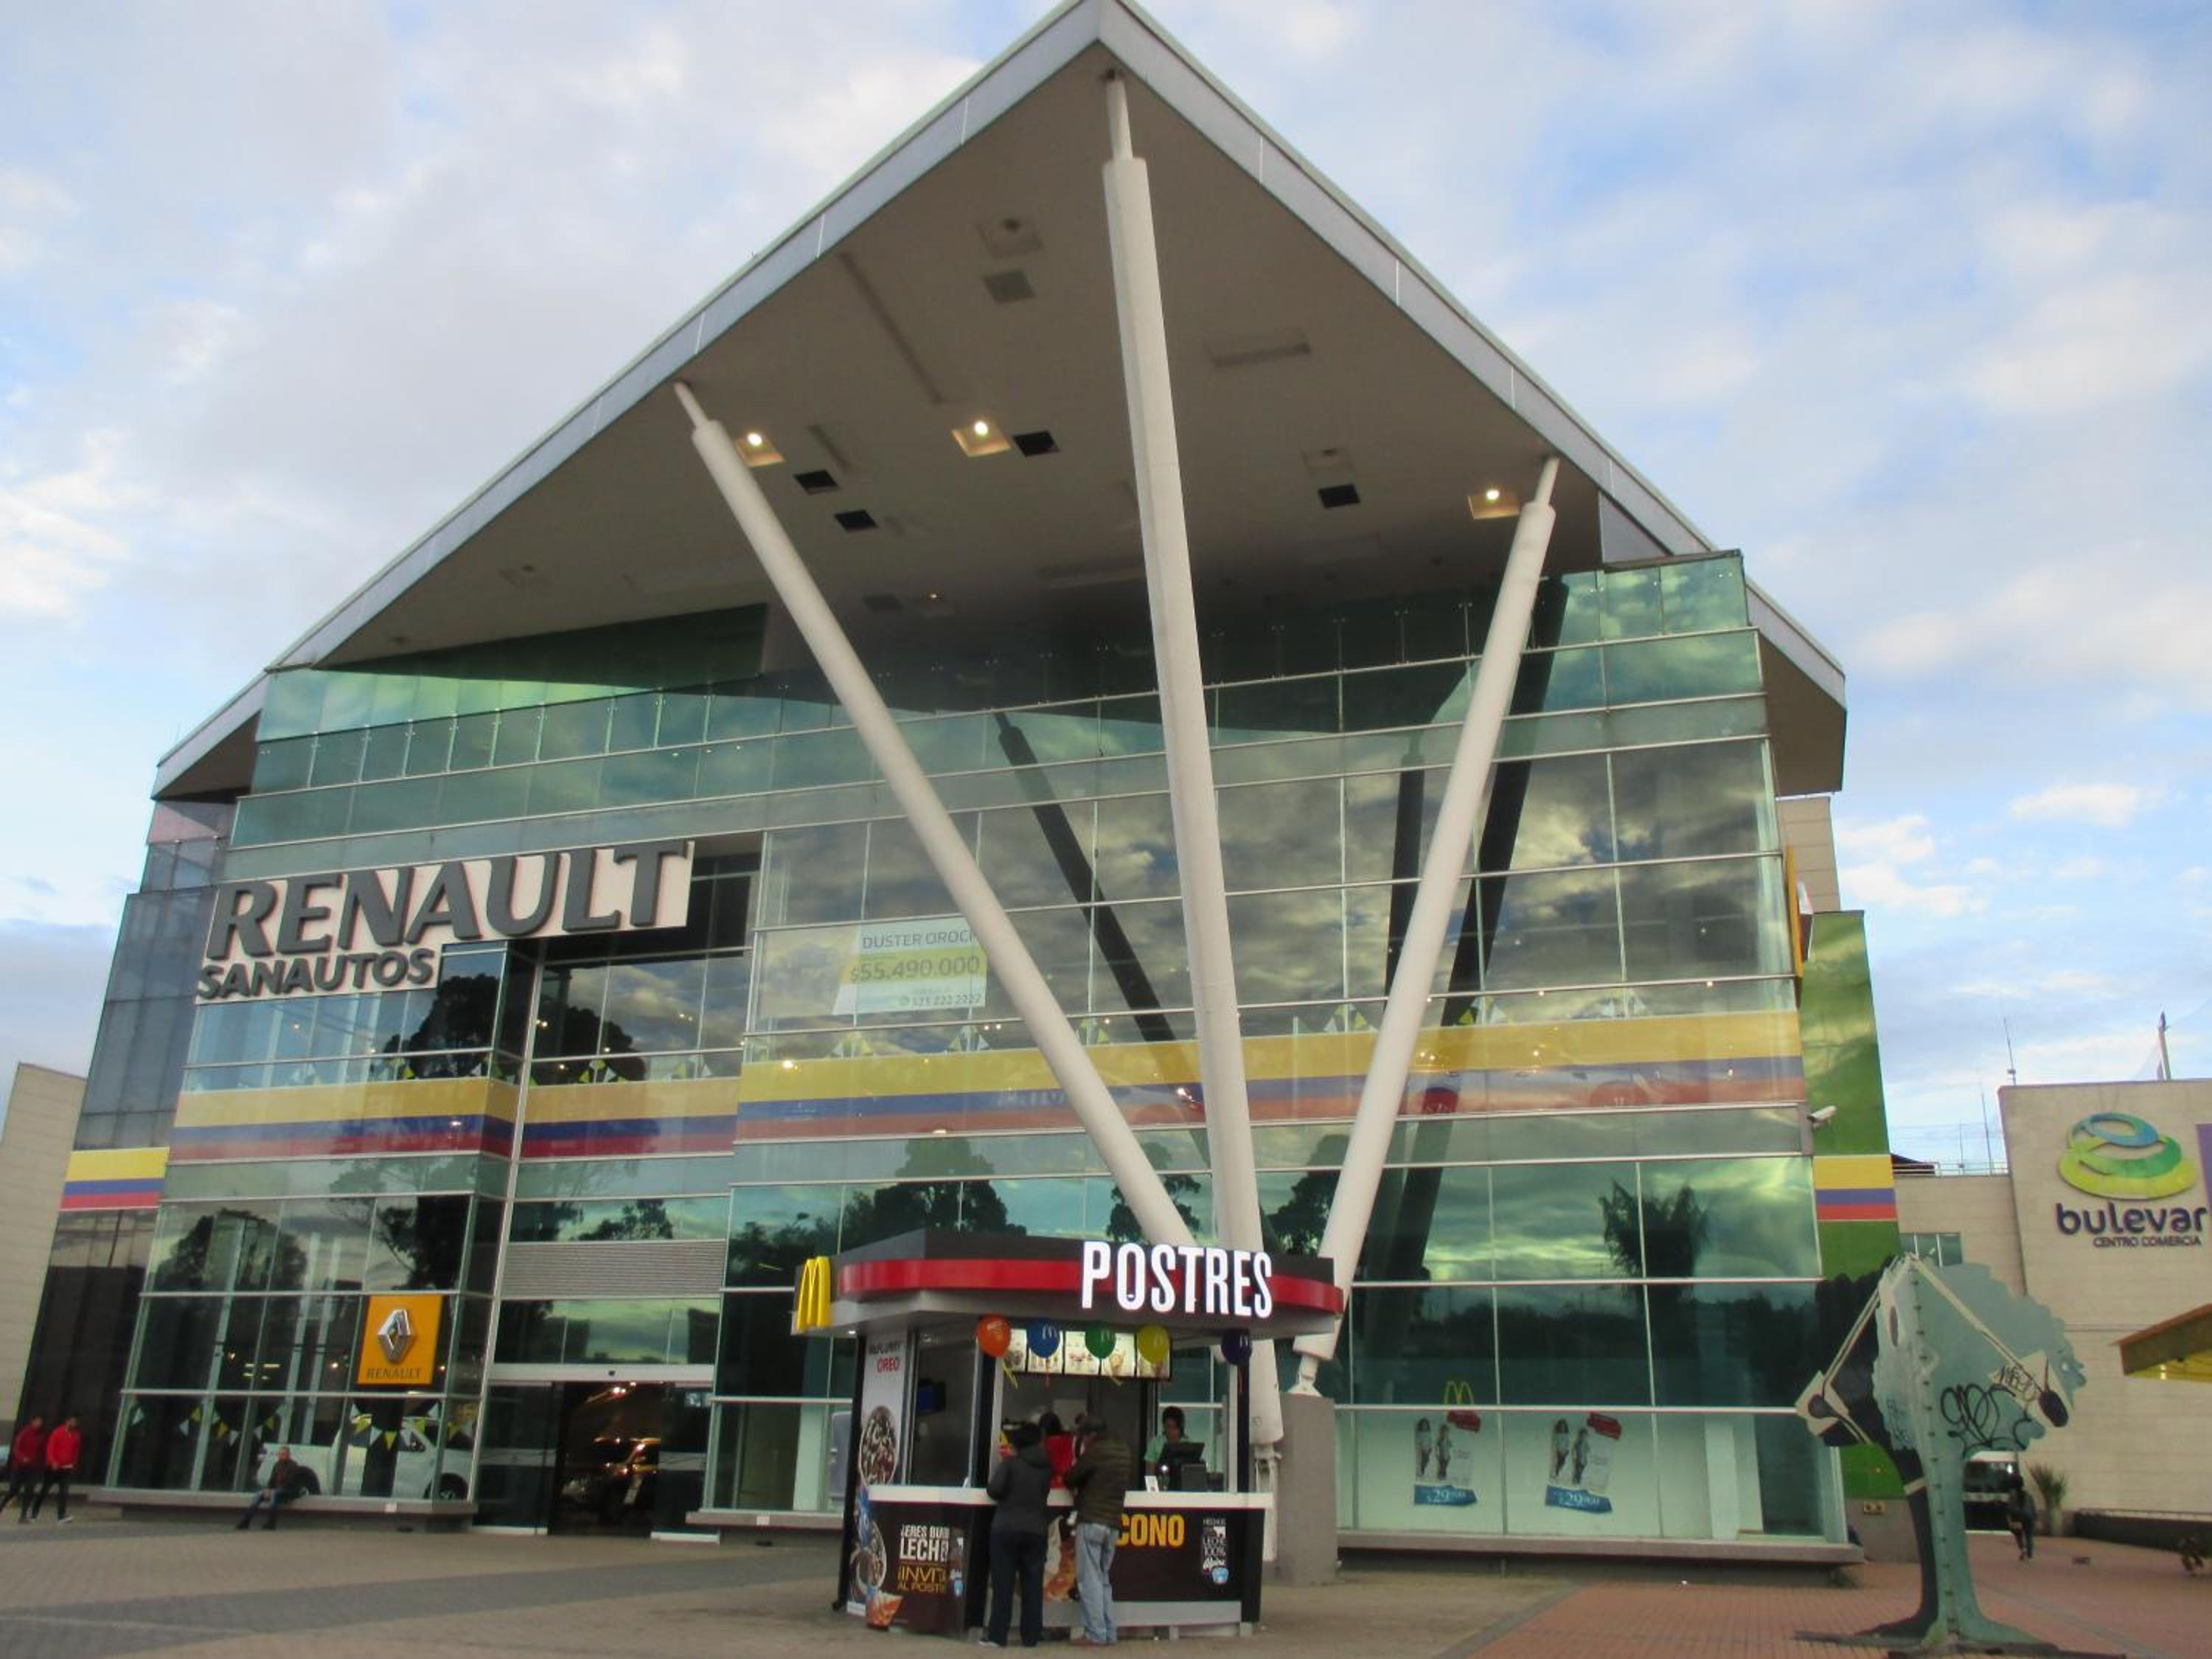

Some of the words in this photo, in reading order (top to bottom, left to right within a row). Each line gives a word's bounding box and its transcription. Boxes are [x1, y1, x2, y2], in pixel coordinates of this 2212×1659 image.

[206, 841, 688, 959] RENAULT
[862, 933, 921, 949] DUSTER
[197, 948, 434, 1000] SANAUTOS
[850, 956, 980, 981] $55.490.000
[2056, 1203, 2207, 1235] bulevar
[2093, 1237, 2138, 1248] CENTRO
[1082, 1241, 1273, 1318] POSTRES
[367, 1368, 422, 1379] RENAULT
[1116, 1514, 1184, 1546] CONO
